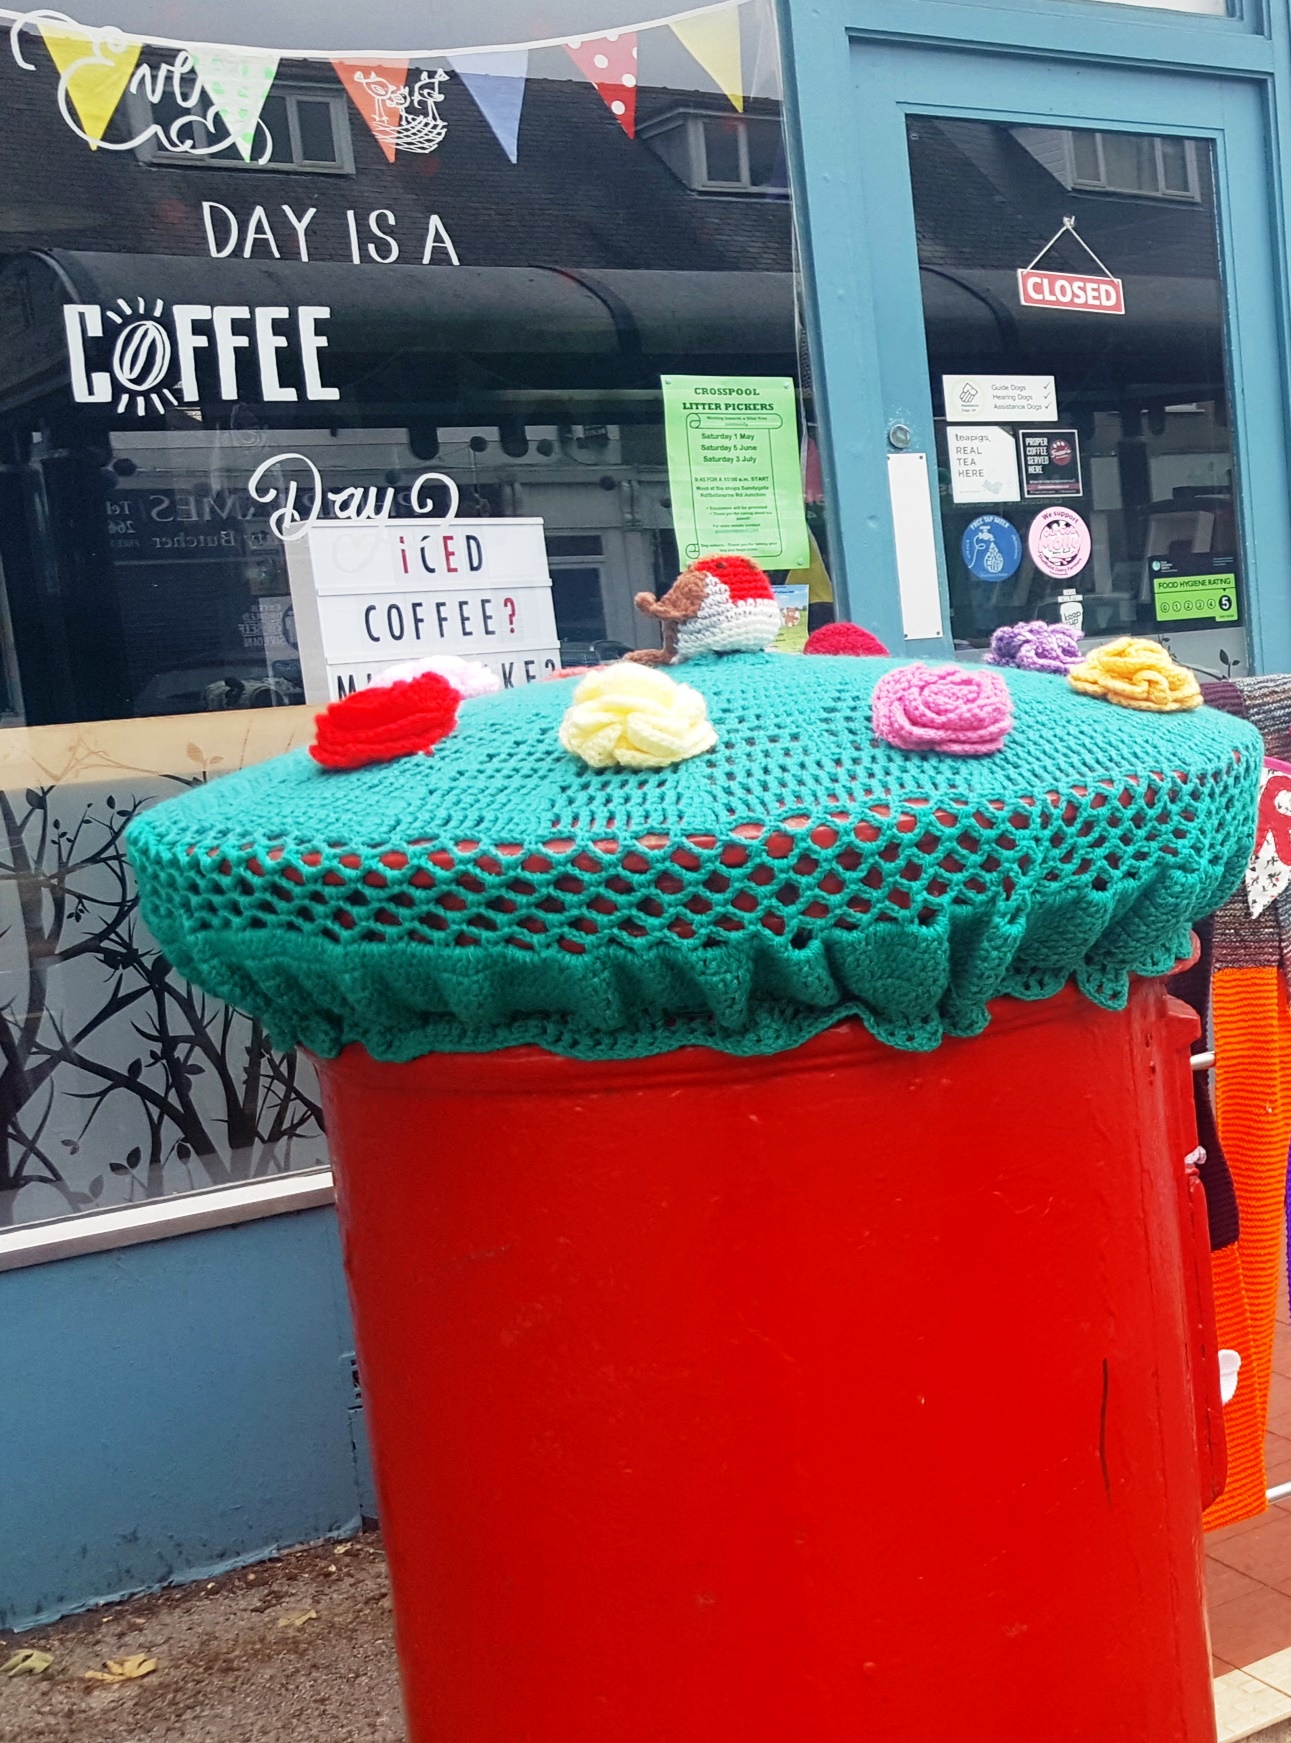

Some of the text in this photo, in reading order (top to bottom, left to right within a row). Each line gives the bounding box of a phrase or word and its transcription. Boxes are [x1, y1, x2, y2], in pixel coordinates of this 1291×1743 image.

[202, 201, 461, 266] DAY IS A
[1027, 276, 1117, 307] CLOSED
[63, 298, 341, 412] COFFEE
[694, 387, 760, 396] CROSSPOOL
[682, 402, 774, 411] LITTER PICKERS
[701, 433, 732, 441] Saturday
[740, 433, 755, 441] May
[1025, 438, 1048, 446] PROPER
[701, 444, 732, 452] Saturday
[956, 446, 983, 455] REAL
[1026, 447, 1048, 455] COFFEE
[957, 458, 977, 466] TEA
[958, 469, 985, 477] HERE
[1028, 465, 1043, 474] HERE
[248, 453, 459, 542] Day
[1054, 511, 1079, 524] support
[1158, 577, 1231, 589] FOOD HYGIENE RATING
[1221, 596, 1230, 609] 5
[364, 597, 517, 642] COFFEE?
